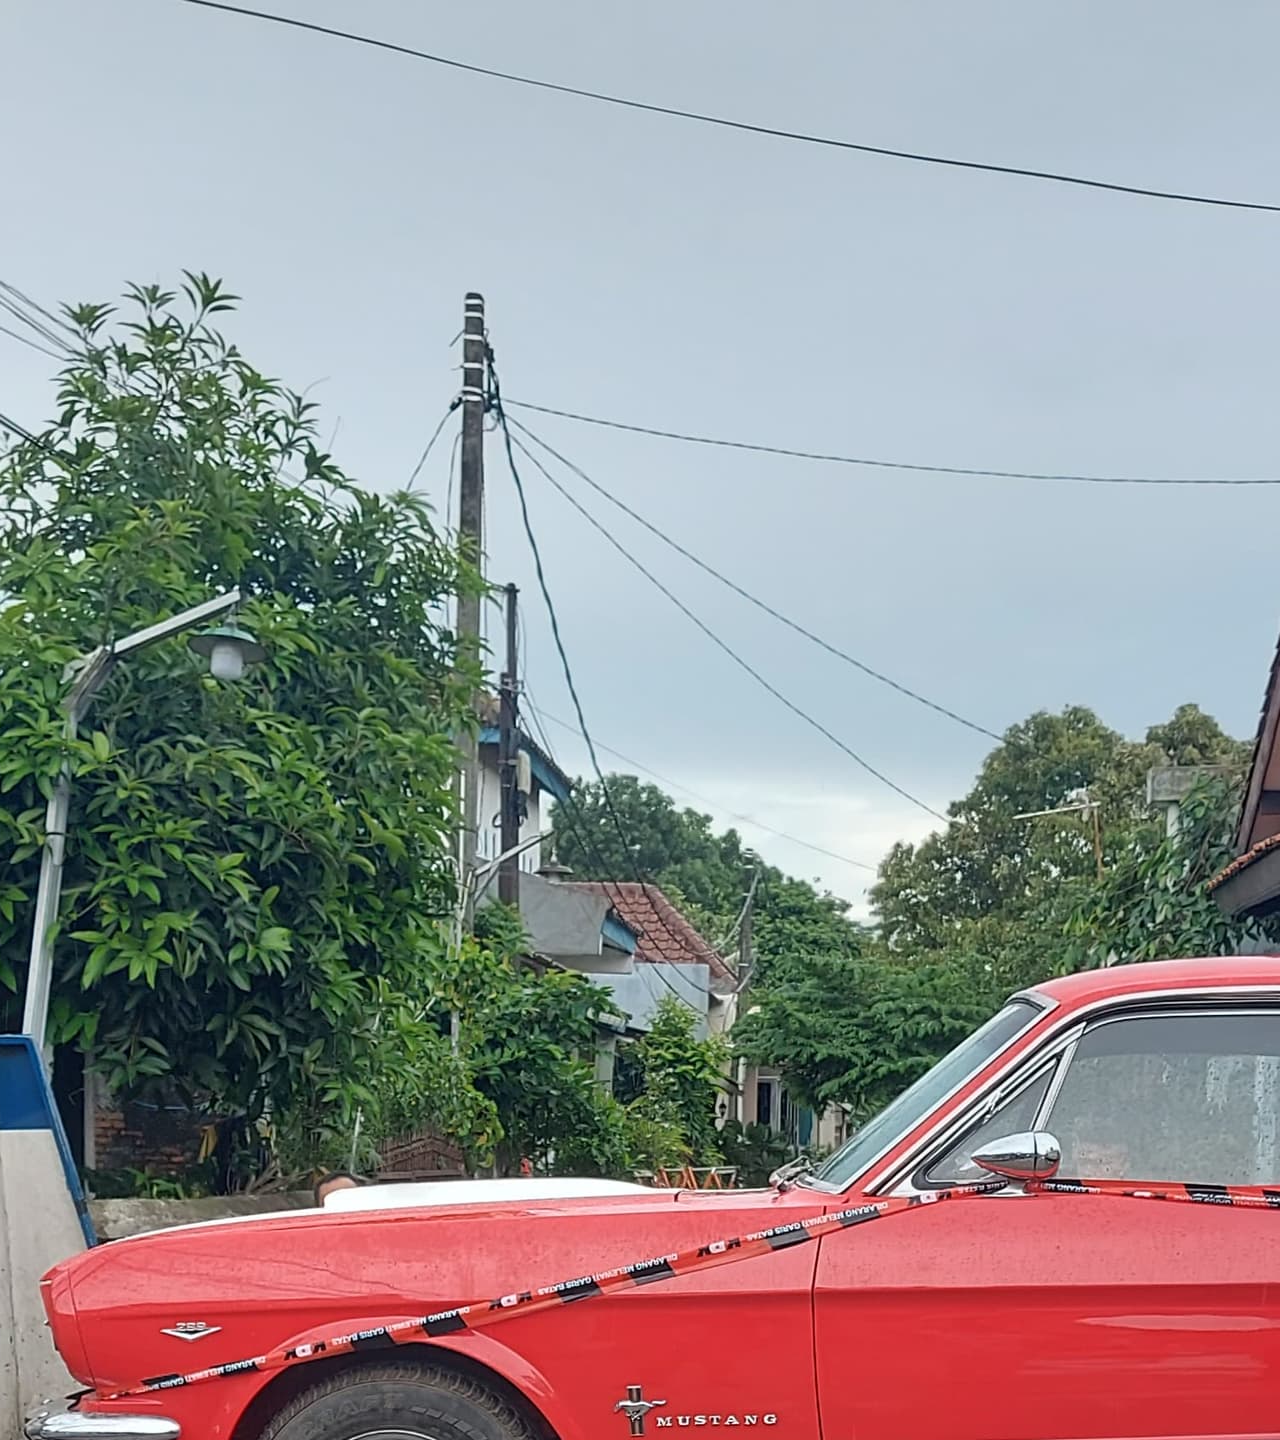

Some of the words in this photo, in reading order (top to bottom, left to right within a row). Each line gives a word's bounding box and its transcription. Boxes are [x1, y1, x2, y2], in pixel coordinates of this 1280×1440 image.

[774, 1222, 801, 1234] GARIS
[746, 1230, 773, 1241] BATAS
[565, 1276, 592, 1289] GARIS
[537, 1283, 564, 1296] BATAS
[656, 1414, 778, 1427] MUSTANG
